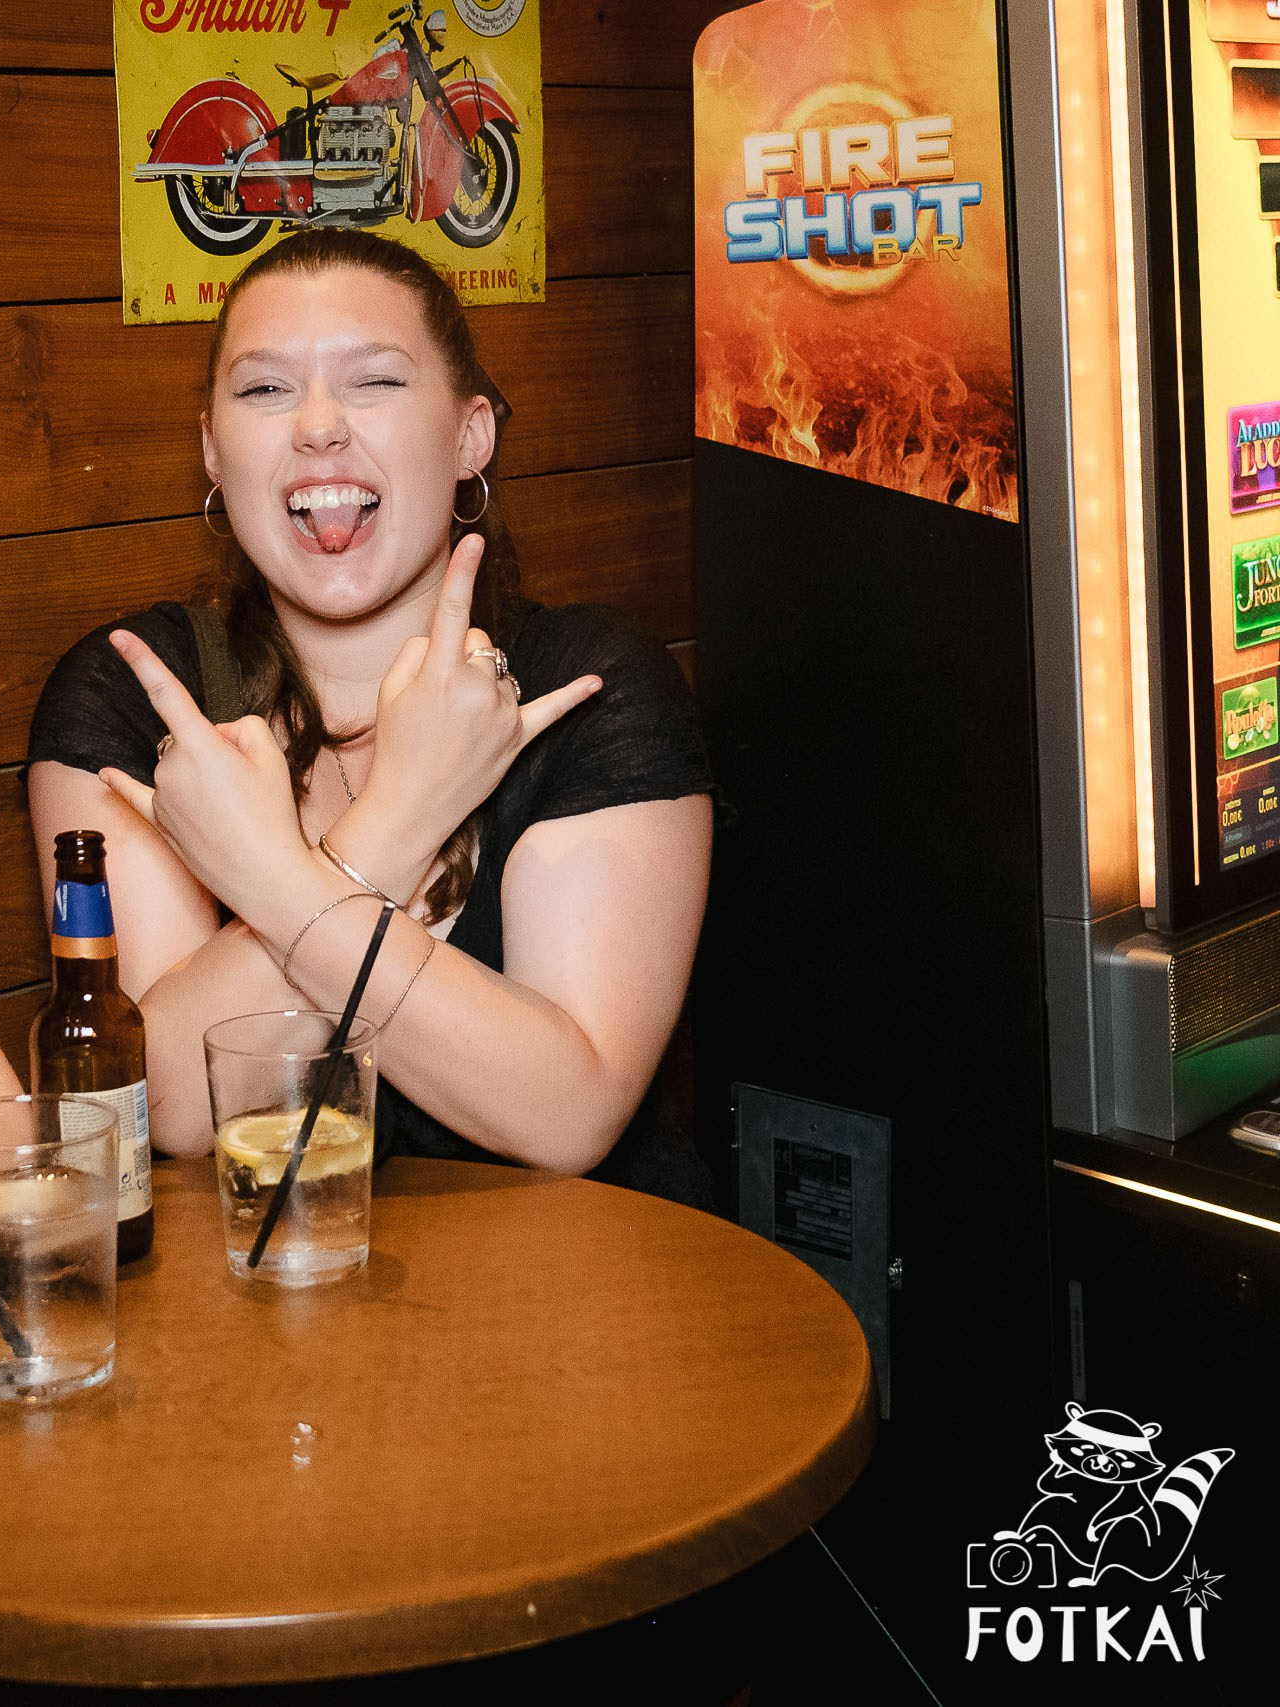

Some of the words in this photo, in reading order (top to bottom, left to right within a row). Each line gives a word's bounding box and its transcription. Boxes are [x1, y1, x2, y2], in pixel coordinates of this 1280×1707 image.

[742, 117, 956, 198] FIRE
[724, 182, 982, 263] SHOT
[873, 234, 961, 266] BAR
[165, 283, 176, 305] A
[441, 268, 518, 290] NEERING
[1237, 556, 1280, 612] JUN
